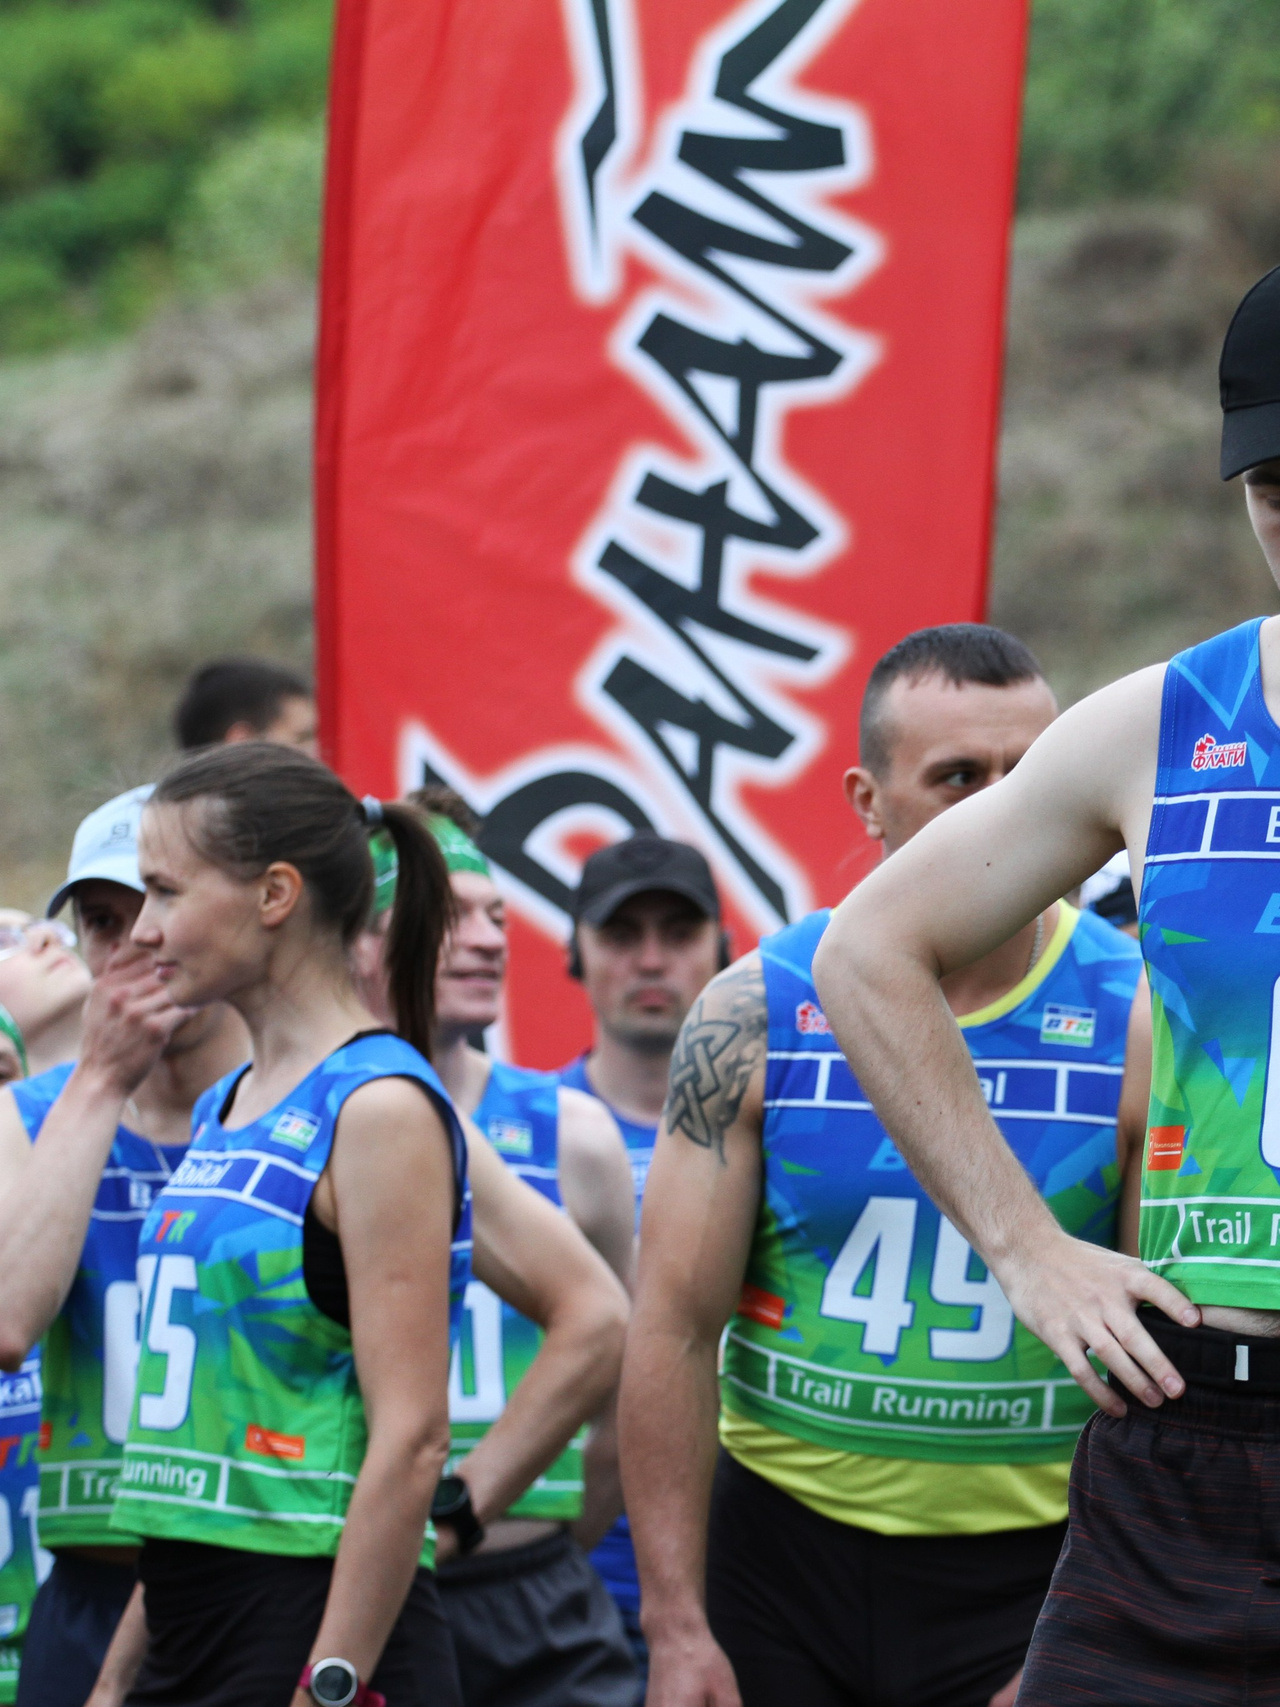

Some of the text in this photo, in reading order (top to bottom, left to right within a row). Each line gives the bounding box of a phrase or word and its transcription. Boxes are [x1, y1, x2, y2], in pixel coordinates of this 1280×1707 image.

[1192, 750, 1246, 771] ФЛАГИ
[1190, 1211, 1251, 1245] Trail
[820, 1195, 1015, 1361] 49
[787, 1368, 1032, 1427] Trail Running
[122, 1458, 208, 1497] unning
